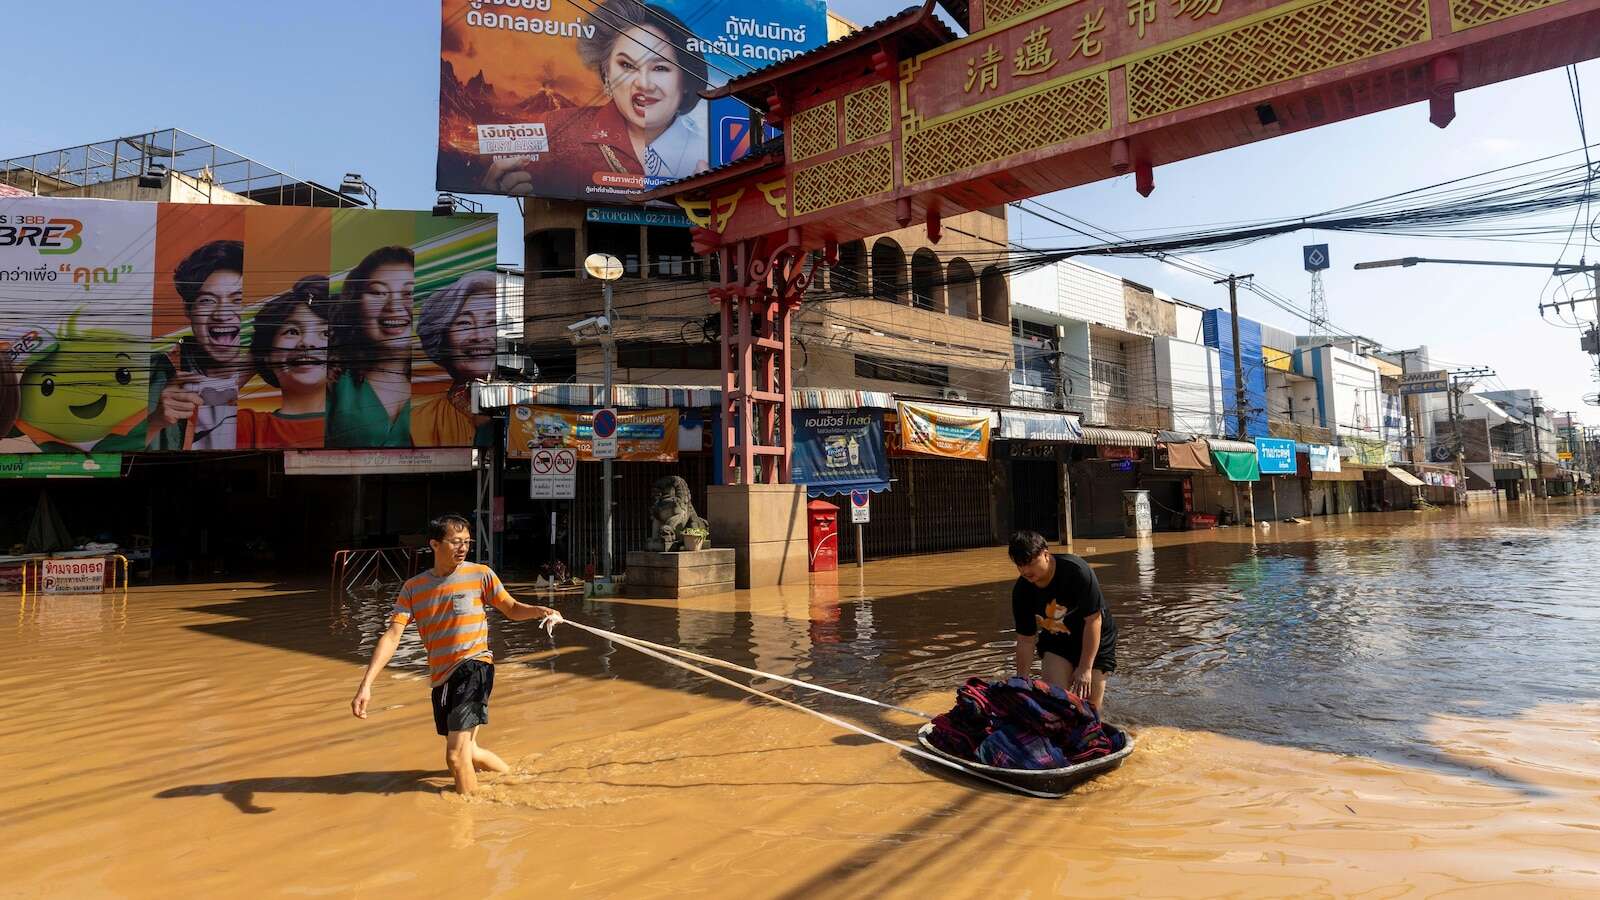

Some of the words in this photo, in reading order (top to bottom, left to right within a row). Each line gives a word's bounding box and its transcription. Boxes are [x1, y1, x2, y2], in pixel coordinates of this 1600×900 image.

[725, 15, 806, 43] กู้ฟินนิกซ์
[685, 36, 740, 57] ลดต้น
[481, 125, 545, 141] เงินกู้ด่วน
[15, 216, 45, 225] 3BB
[600, 208, 641, 222] TOPGUN
[805, 415, 844, 428] เอนชัวร์
[46, 561, 104, 575] ห้ามจอดรถ
